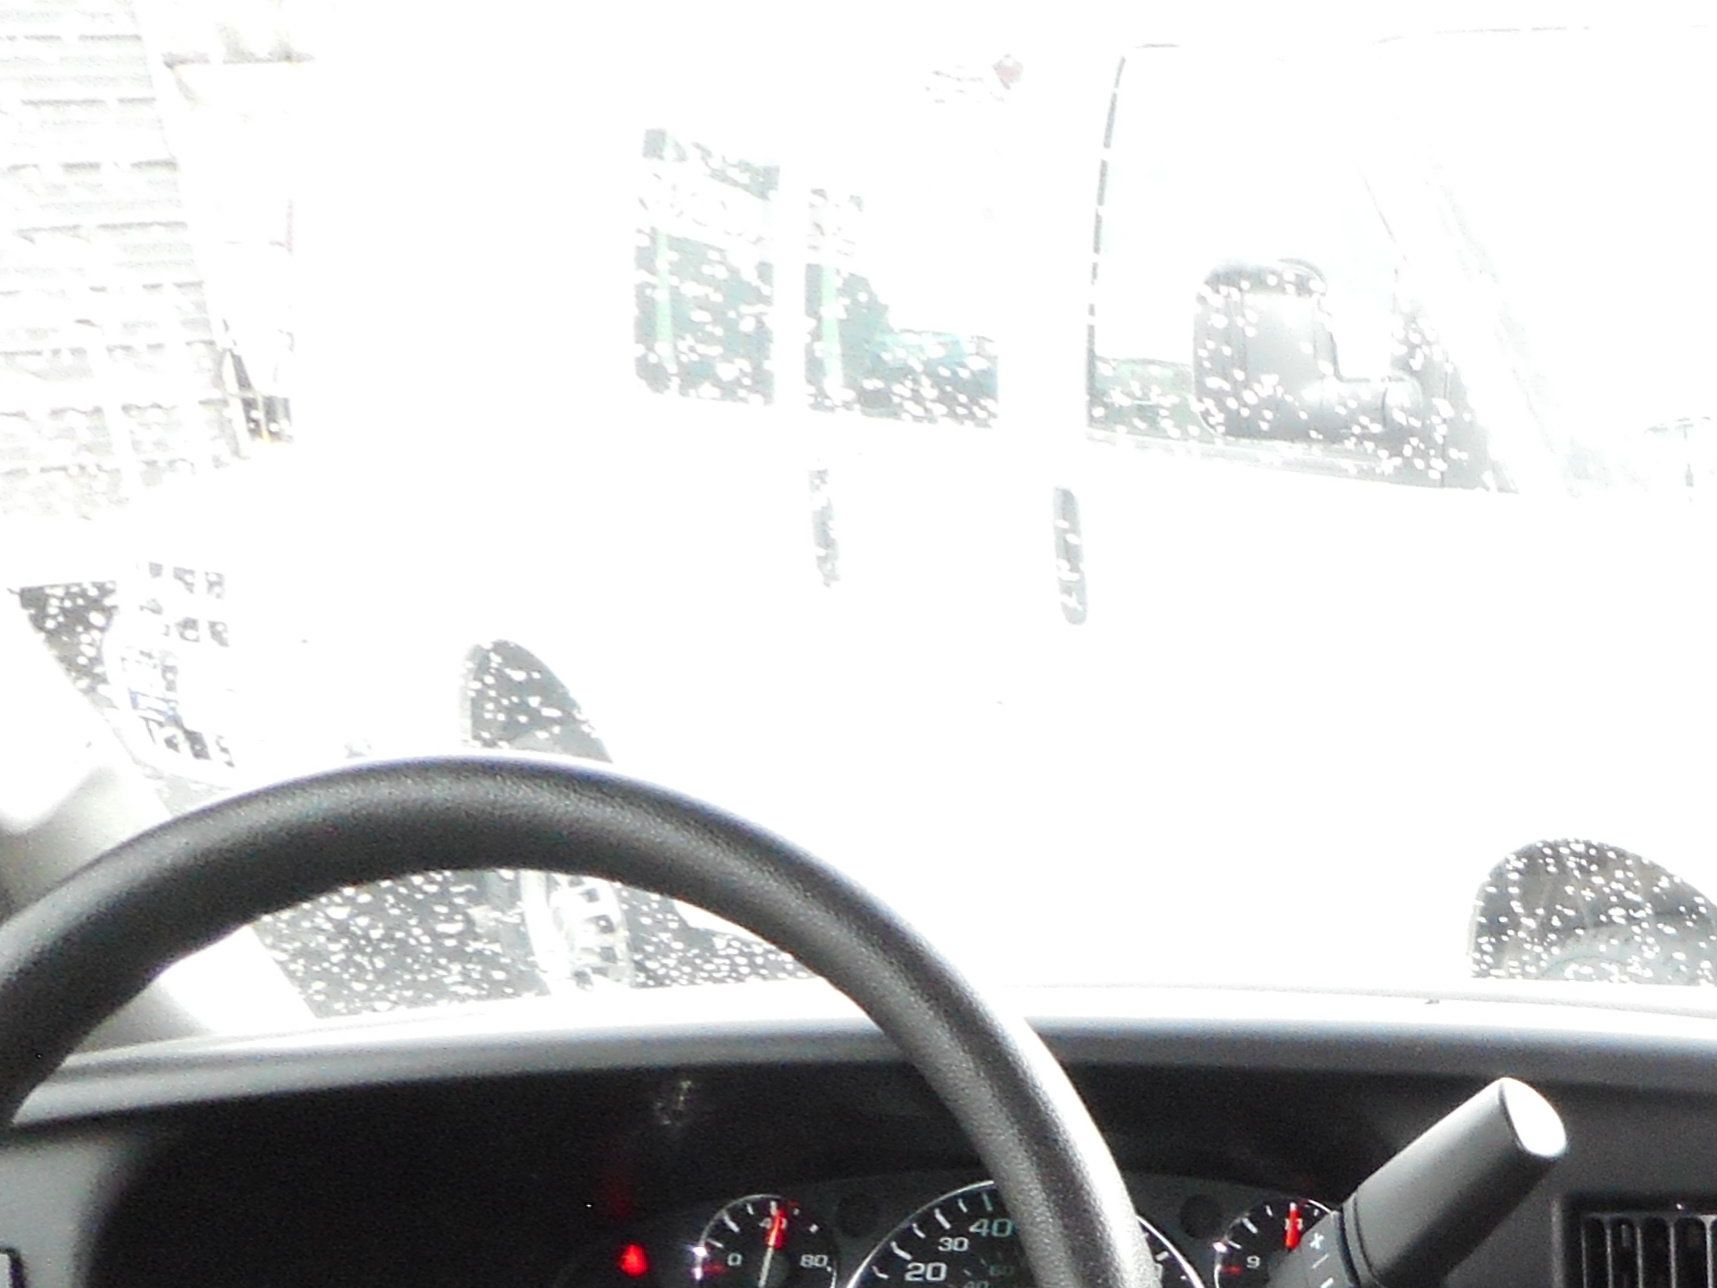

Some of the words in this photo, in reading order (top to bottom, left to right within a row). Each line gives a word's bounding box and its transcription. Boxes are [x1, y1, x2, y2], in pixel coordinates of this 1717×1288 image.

[969, 1218, 1013, 1238] 40
[937, 1236, 970, 1252] 30
[726, 1252, 743, 1267] 0
[800, 1253, 829, 1268] 80
[1246, 1255, 1261, 1270] 9
[904, 1261, 948, 1282] 20
